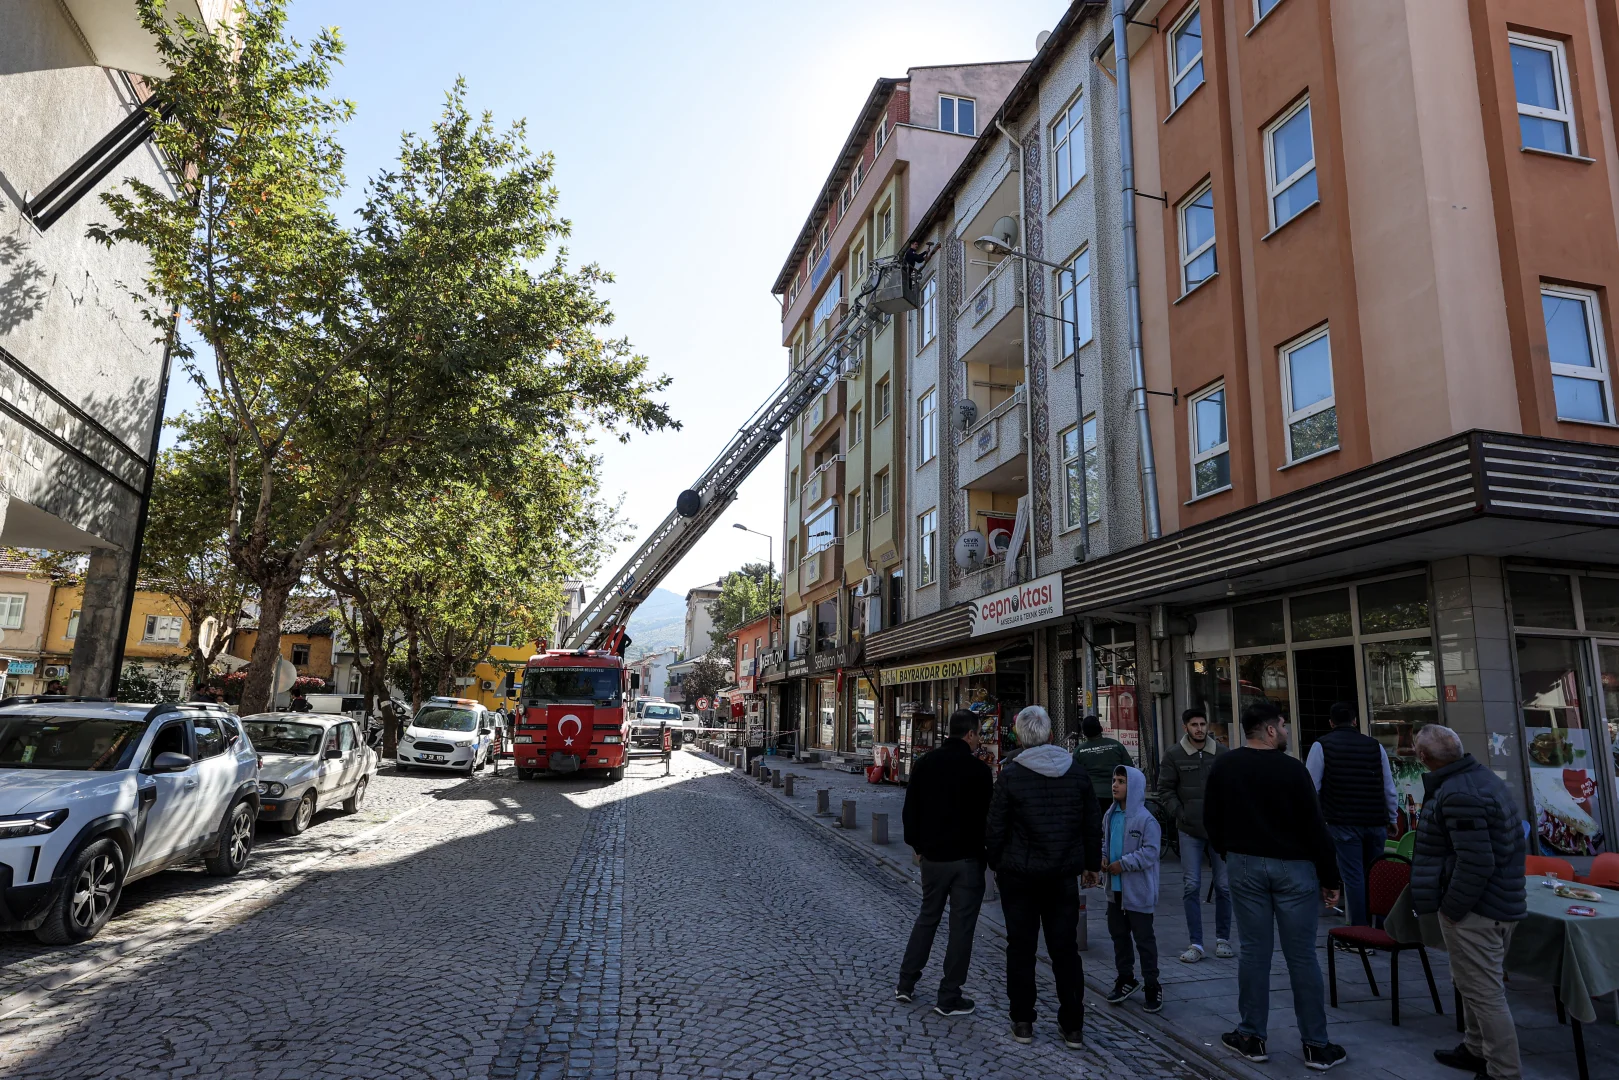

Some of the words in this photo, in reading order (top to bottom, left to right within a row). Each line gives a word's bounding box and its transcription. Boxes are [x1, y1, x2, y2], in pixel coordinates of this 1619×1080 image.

[981, 584, 1052, 623] cepnoktası
[899, 665, 940, 683] BAYRAKDAR
[941, 661, 964, 678] GIDA
